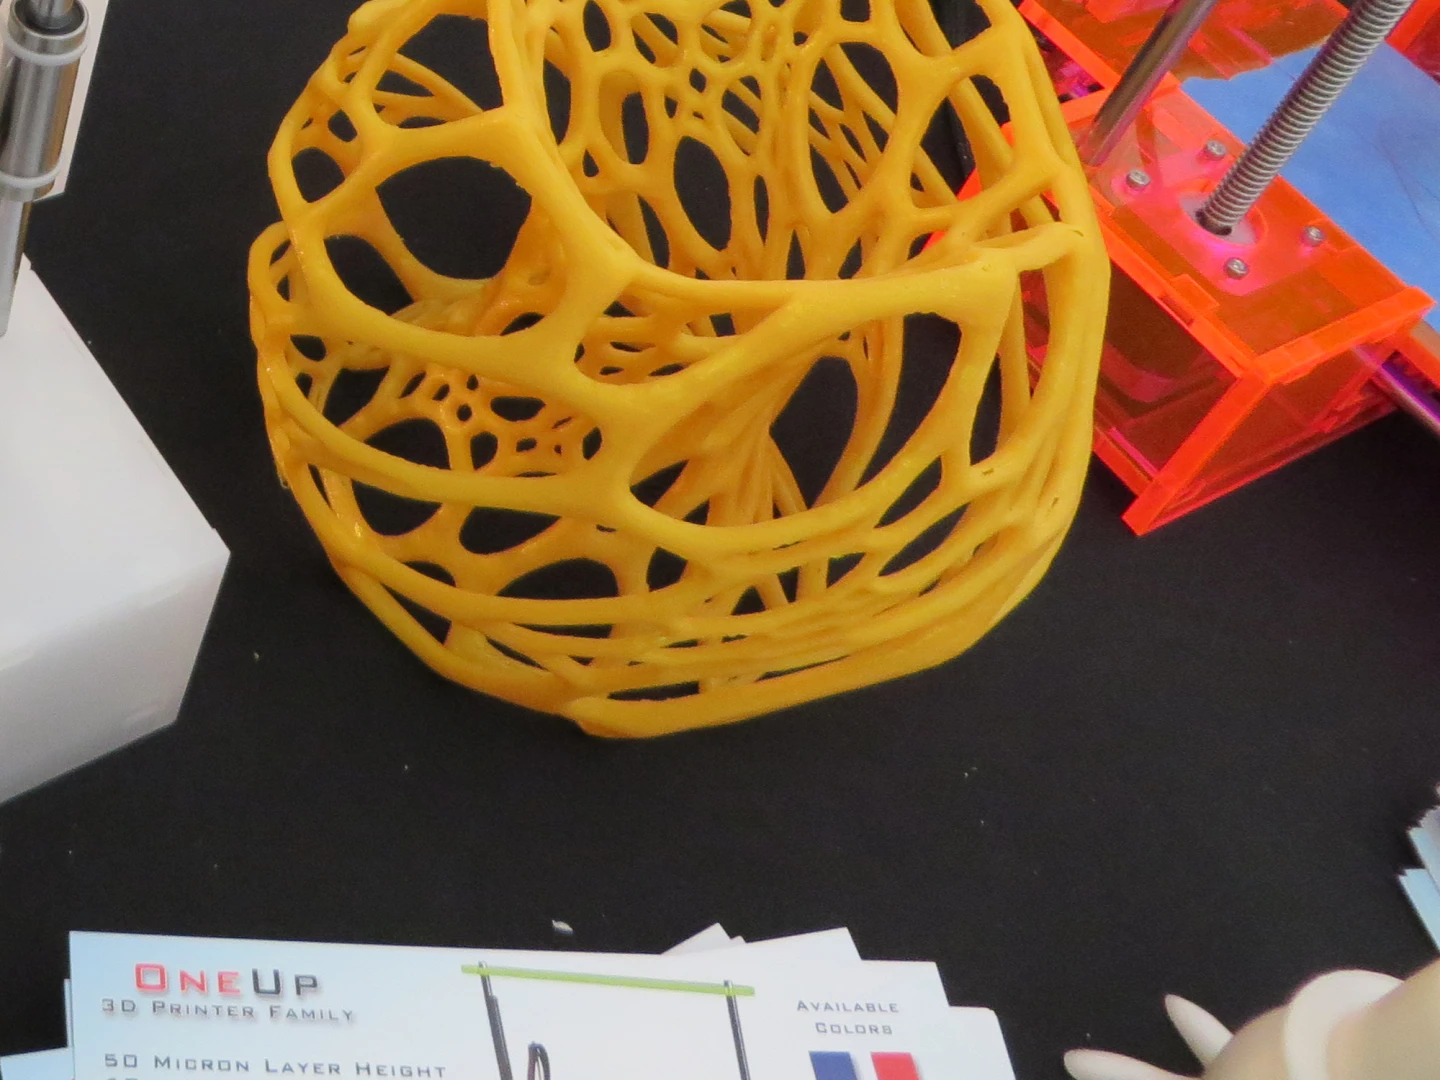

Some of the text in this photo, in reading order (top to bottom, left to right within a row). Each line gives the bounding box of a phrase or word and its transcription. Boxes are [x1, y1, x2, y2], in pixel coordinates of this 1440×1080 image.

[101, 998, 355, 1021] 3D PRINTER FAMILY
[796, 999, 900, 1014] AVAILABLE
[104, 1052, 446, 1078] 50 MICRON LAYER HEIGHT
